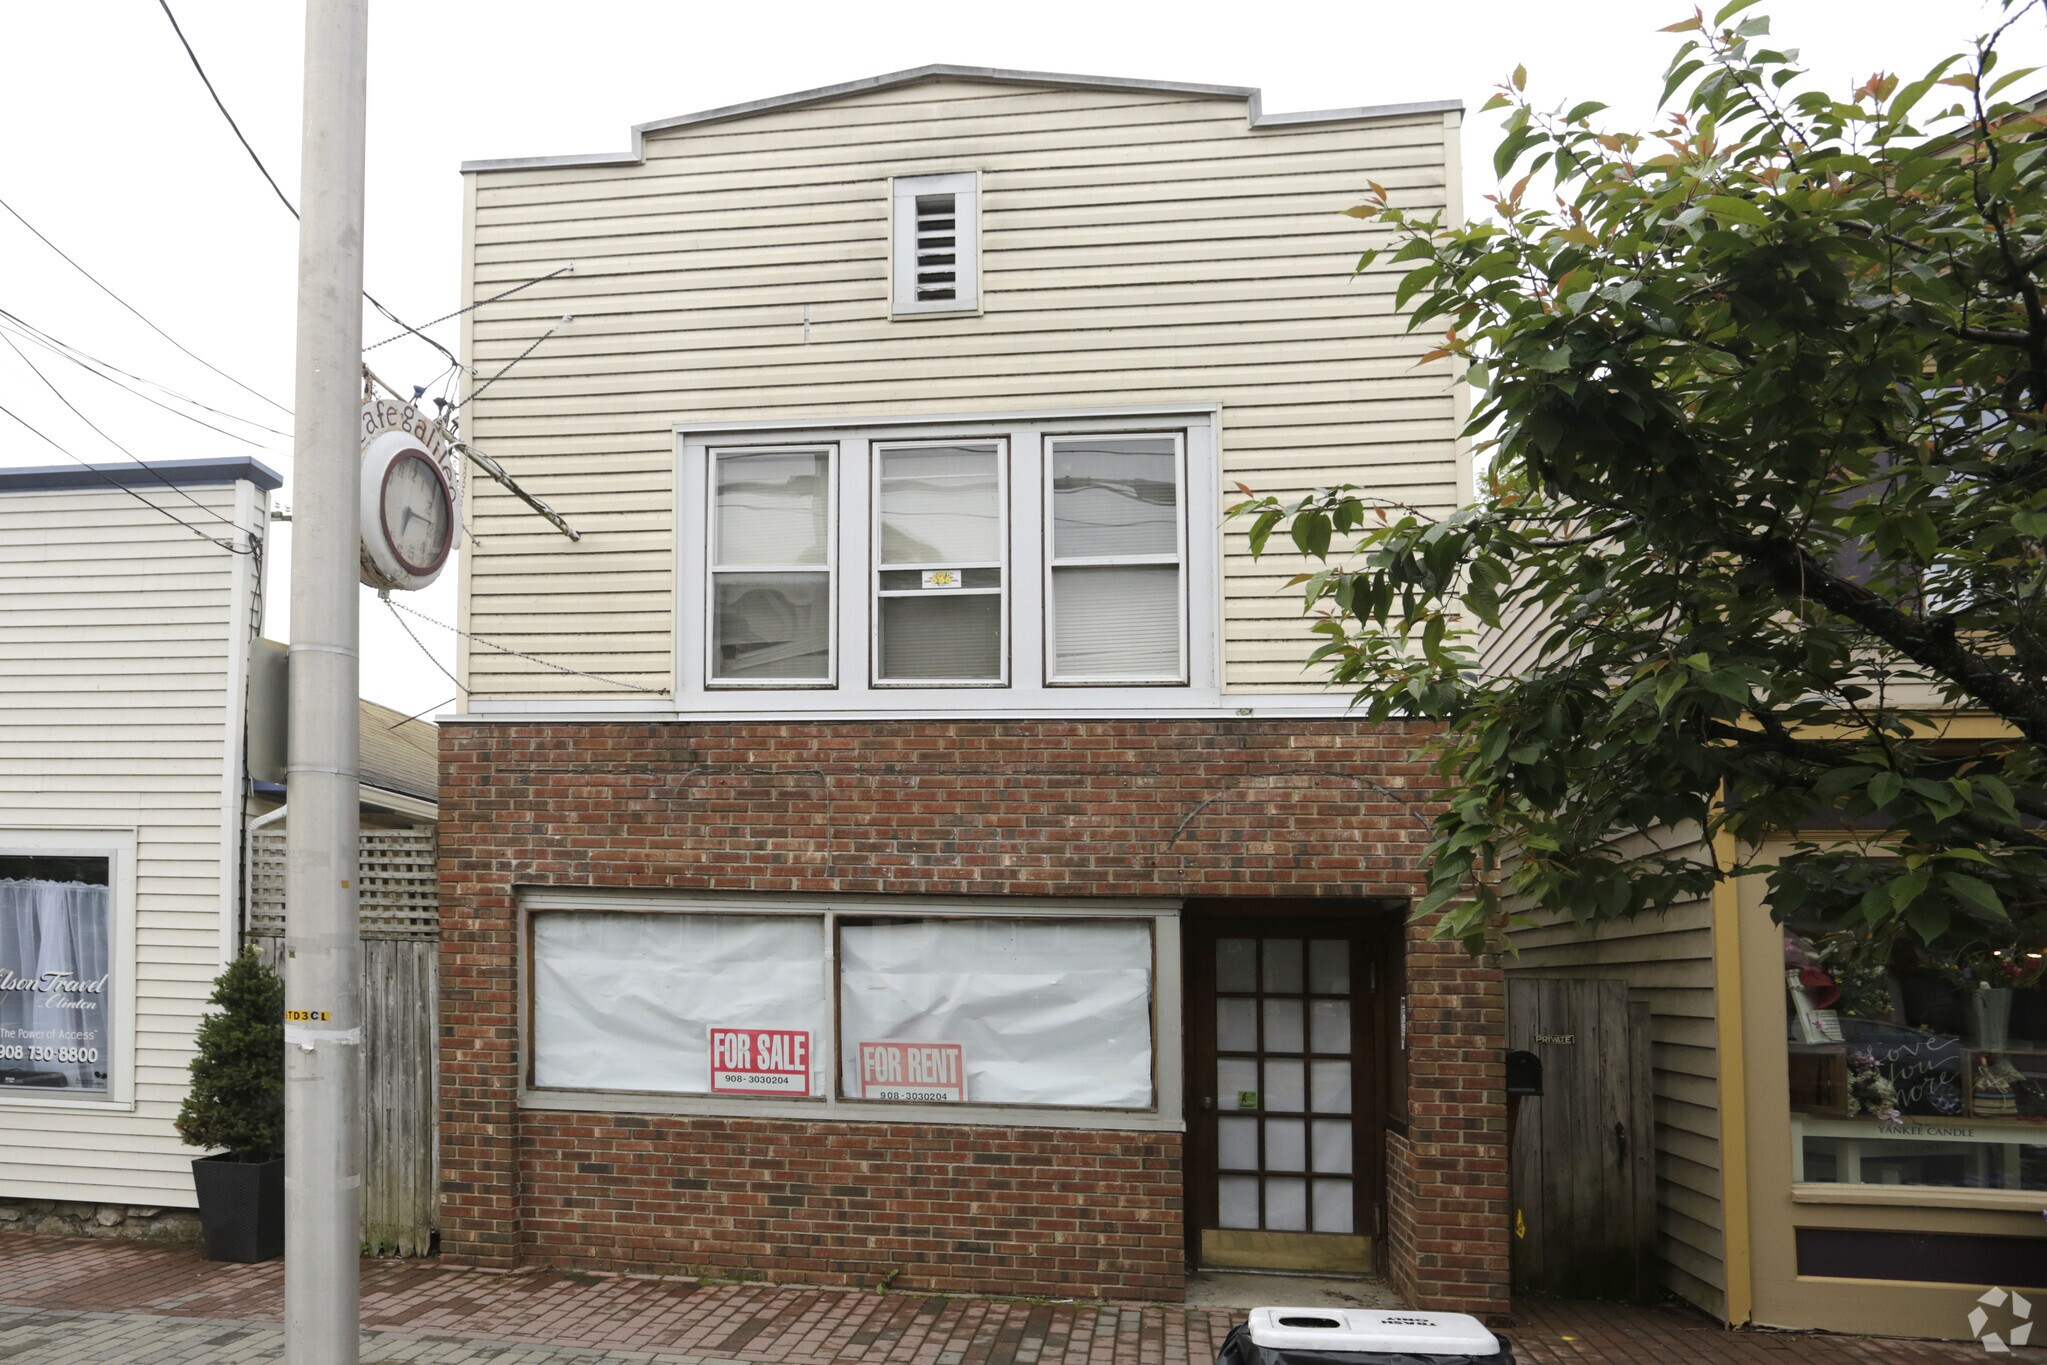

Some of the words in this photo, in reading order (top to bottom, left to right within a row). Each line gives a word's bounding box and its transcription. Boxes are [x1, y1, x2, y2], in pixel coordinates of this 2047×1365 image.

[361, 401, 397, 444] afe
[0, 969, 38, 991] lson
[38, 970, 108, 993] Travel
[45, 993, 96, 1009] Clinton
[0, 1028, 15, 1038] The
[18, 1029, 44, 1039] Power
[46, 1030, 56, 1039] of
[1535, 1035, 1571, 1044] PRIVATE
[713, 1032, 751, 1069] FOR
[757, 1033, 806, 1071] SALE
[863, 1046, 902, 1083] FOR
[907, 1047, 959, 1084] RENT
[1878, 1125, 1923, 1135] YANKEE
[1927, 1126, 1976, 1137] CANDLE
